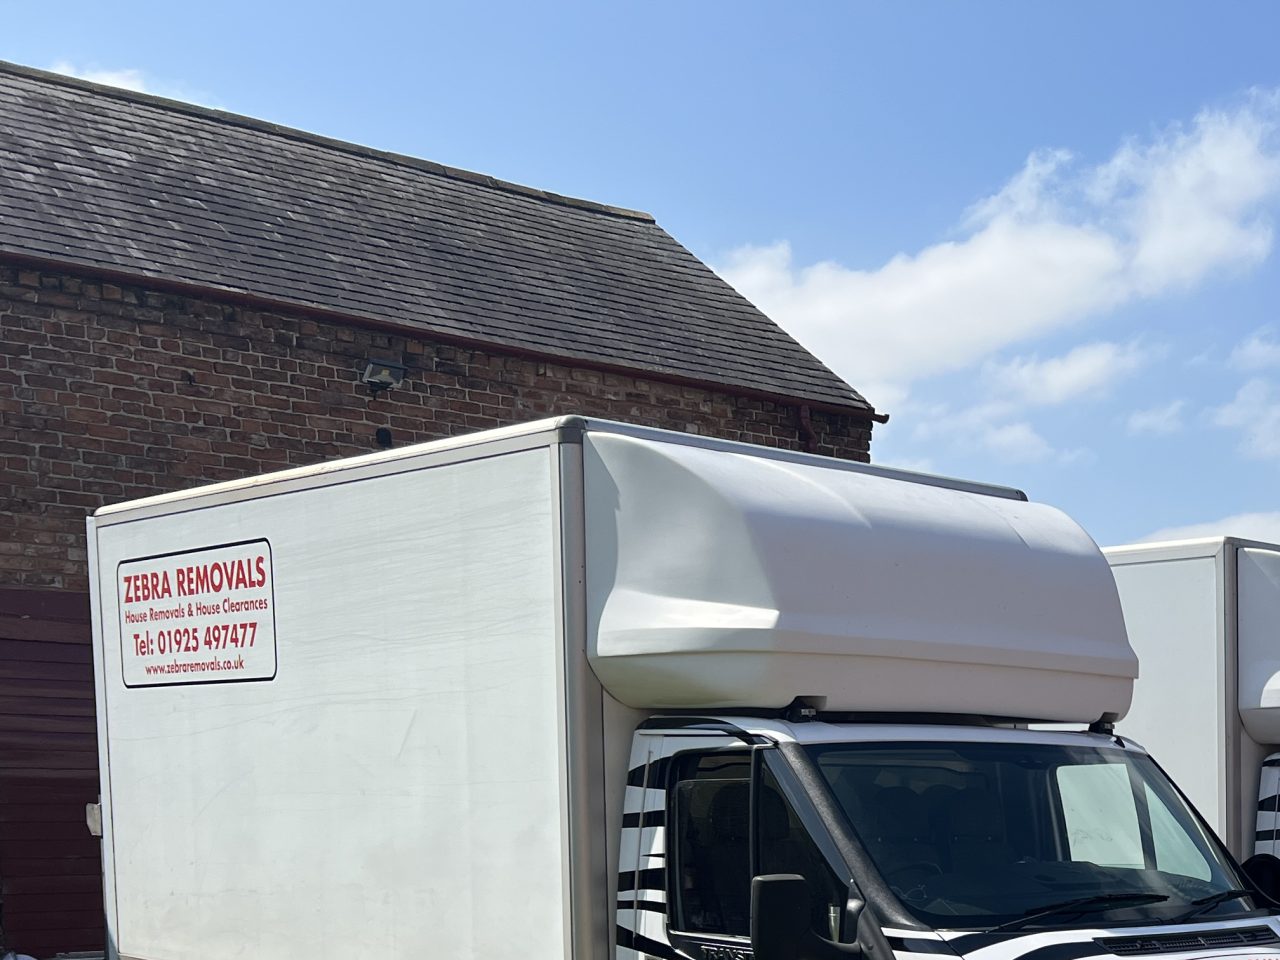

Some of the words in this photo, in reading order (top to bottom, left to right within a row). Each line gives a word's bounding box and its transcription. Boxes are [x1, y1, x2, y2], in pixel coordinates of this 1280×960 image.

[124, 570, 172, 603] ZEBRA
[176, 556, 266, 597] REMOVALS
[125, 610, 147, 624] House
[150, 603, 185, 621] Removals
[187, 603, 194, 617] &
[196, 602, 220, 616] House
[223, 597, 268, 613] Clearances
[133, 631, 154, 656] Tel:
[158, 628, 199, 655] 01925
[204, 622, 257, 650] 497477
[145, 654, 244, 675] www.zebraremovals.co.uk
